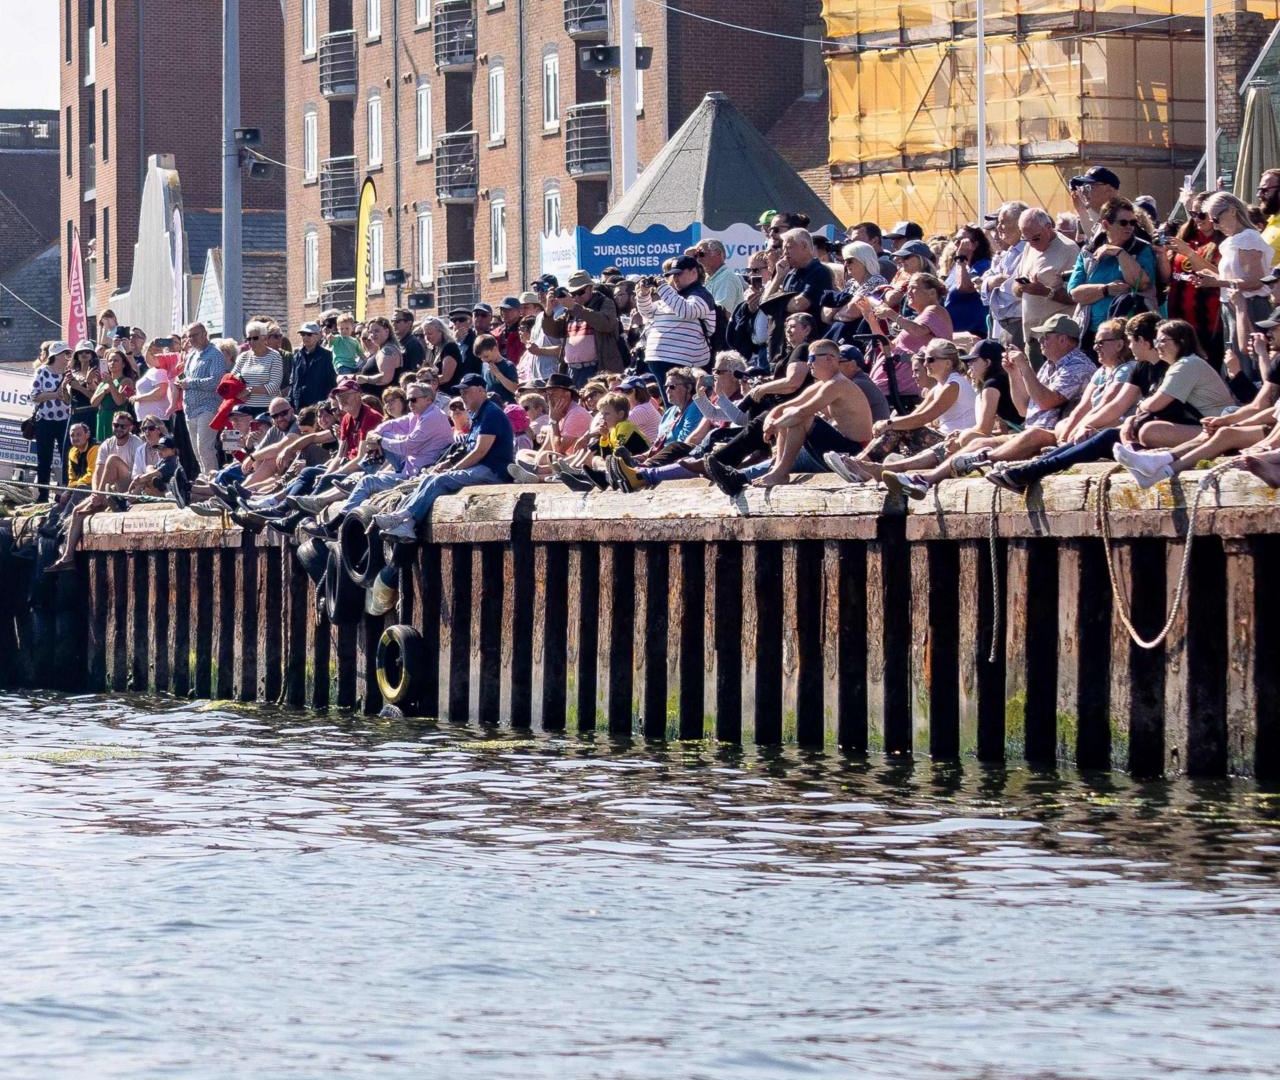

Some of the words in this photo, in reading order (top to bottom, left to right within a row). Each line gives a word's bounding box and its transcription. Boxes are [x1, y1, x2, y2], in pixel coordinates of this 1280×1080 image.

[593, 245, 645, 256] JURASSIC
[647, 243, 682, 254] COAST
[615, 256, 660, 267] CRUISES
